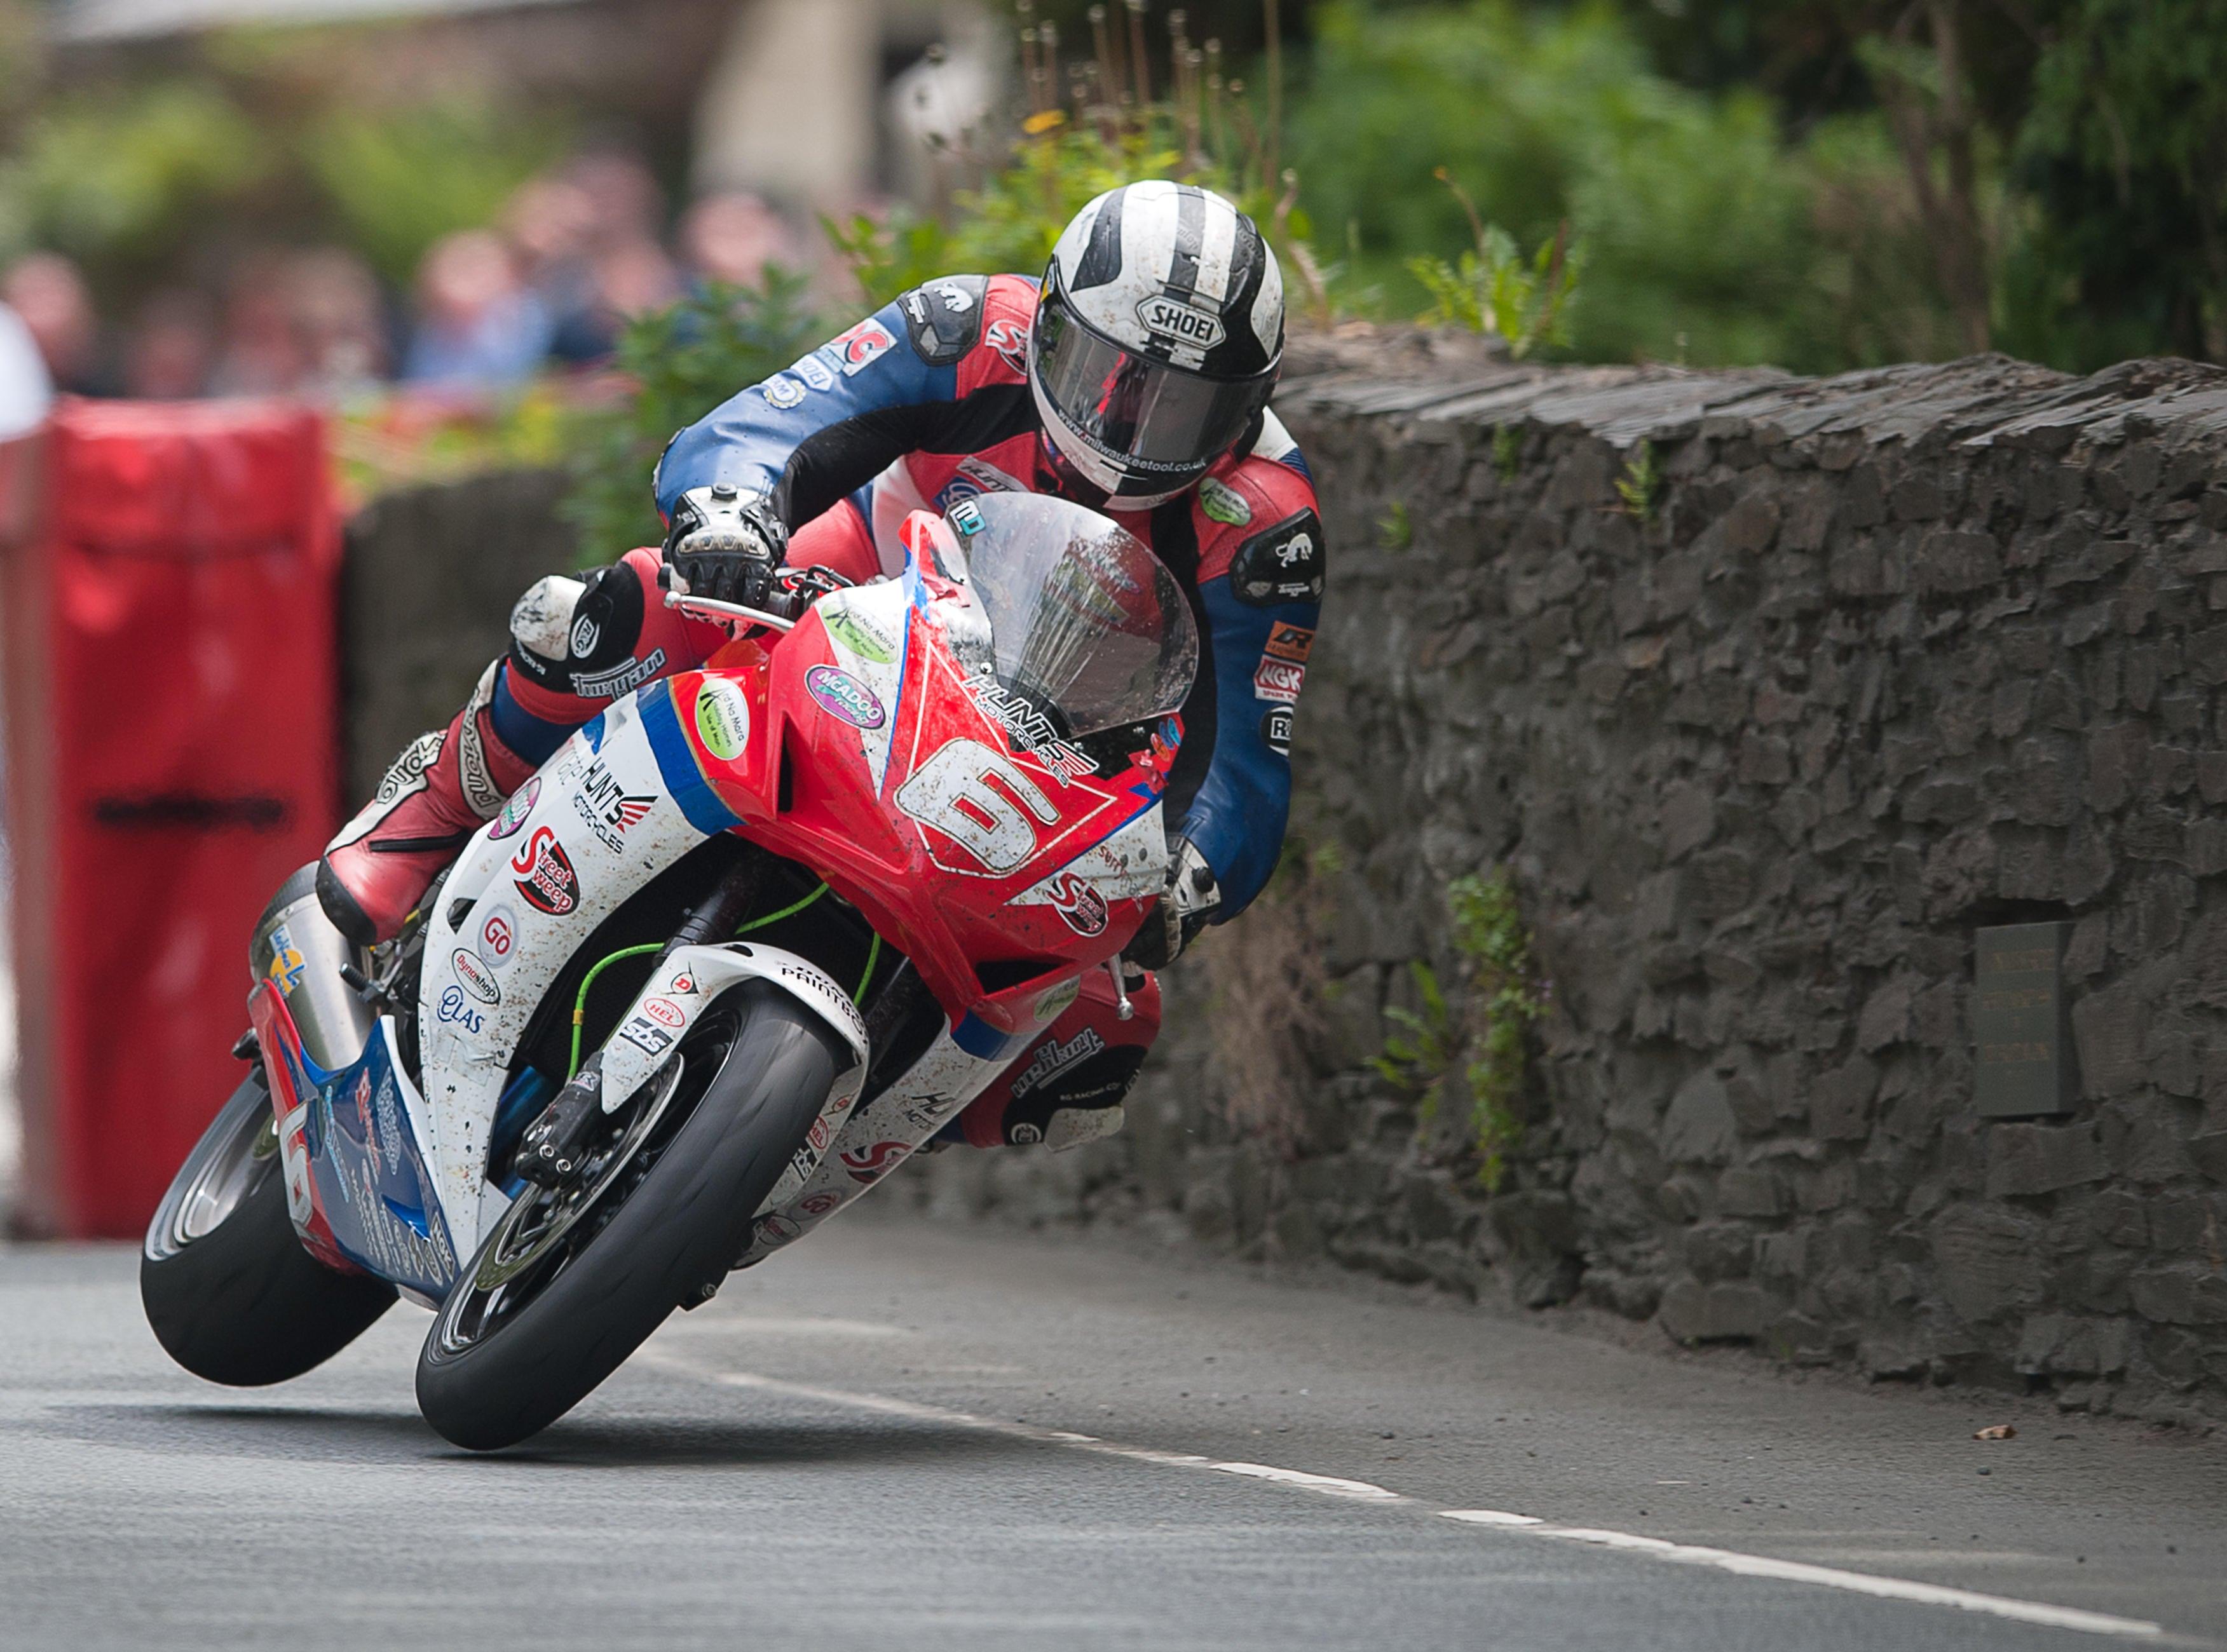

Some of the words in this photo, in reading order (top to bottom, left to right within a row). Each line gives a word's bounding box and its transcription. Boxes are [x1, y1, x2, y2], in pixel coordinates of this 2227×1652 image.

[1150, 304, 1215, 342] SHOEI
[1058, 409, 1206, 472] www.milwaukeetool.co.uk
[873, 628, 896, 651] Mara
[569, 647, 666, 701] Furygan
[1260, 664, 1302, 691] NGK
[731, 716, 745, 741] Mara
[962, 674, 1066, 762] HUNTS
[974, 694, 1070, 789] MOTORCYCLES
[579, 756, 629, 827] HUNTS
[893, 736, 1061, 874] 6
[574, 790, 625, 855] MOTORCYCLES
[456, 954, 496, 998] Dynoshop
[649, 1003, 674, 1024] HEL
